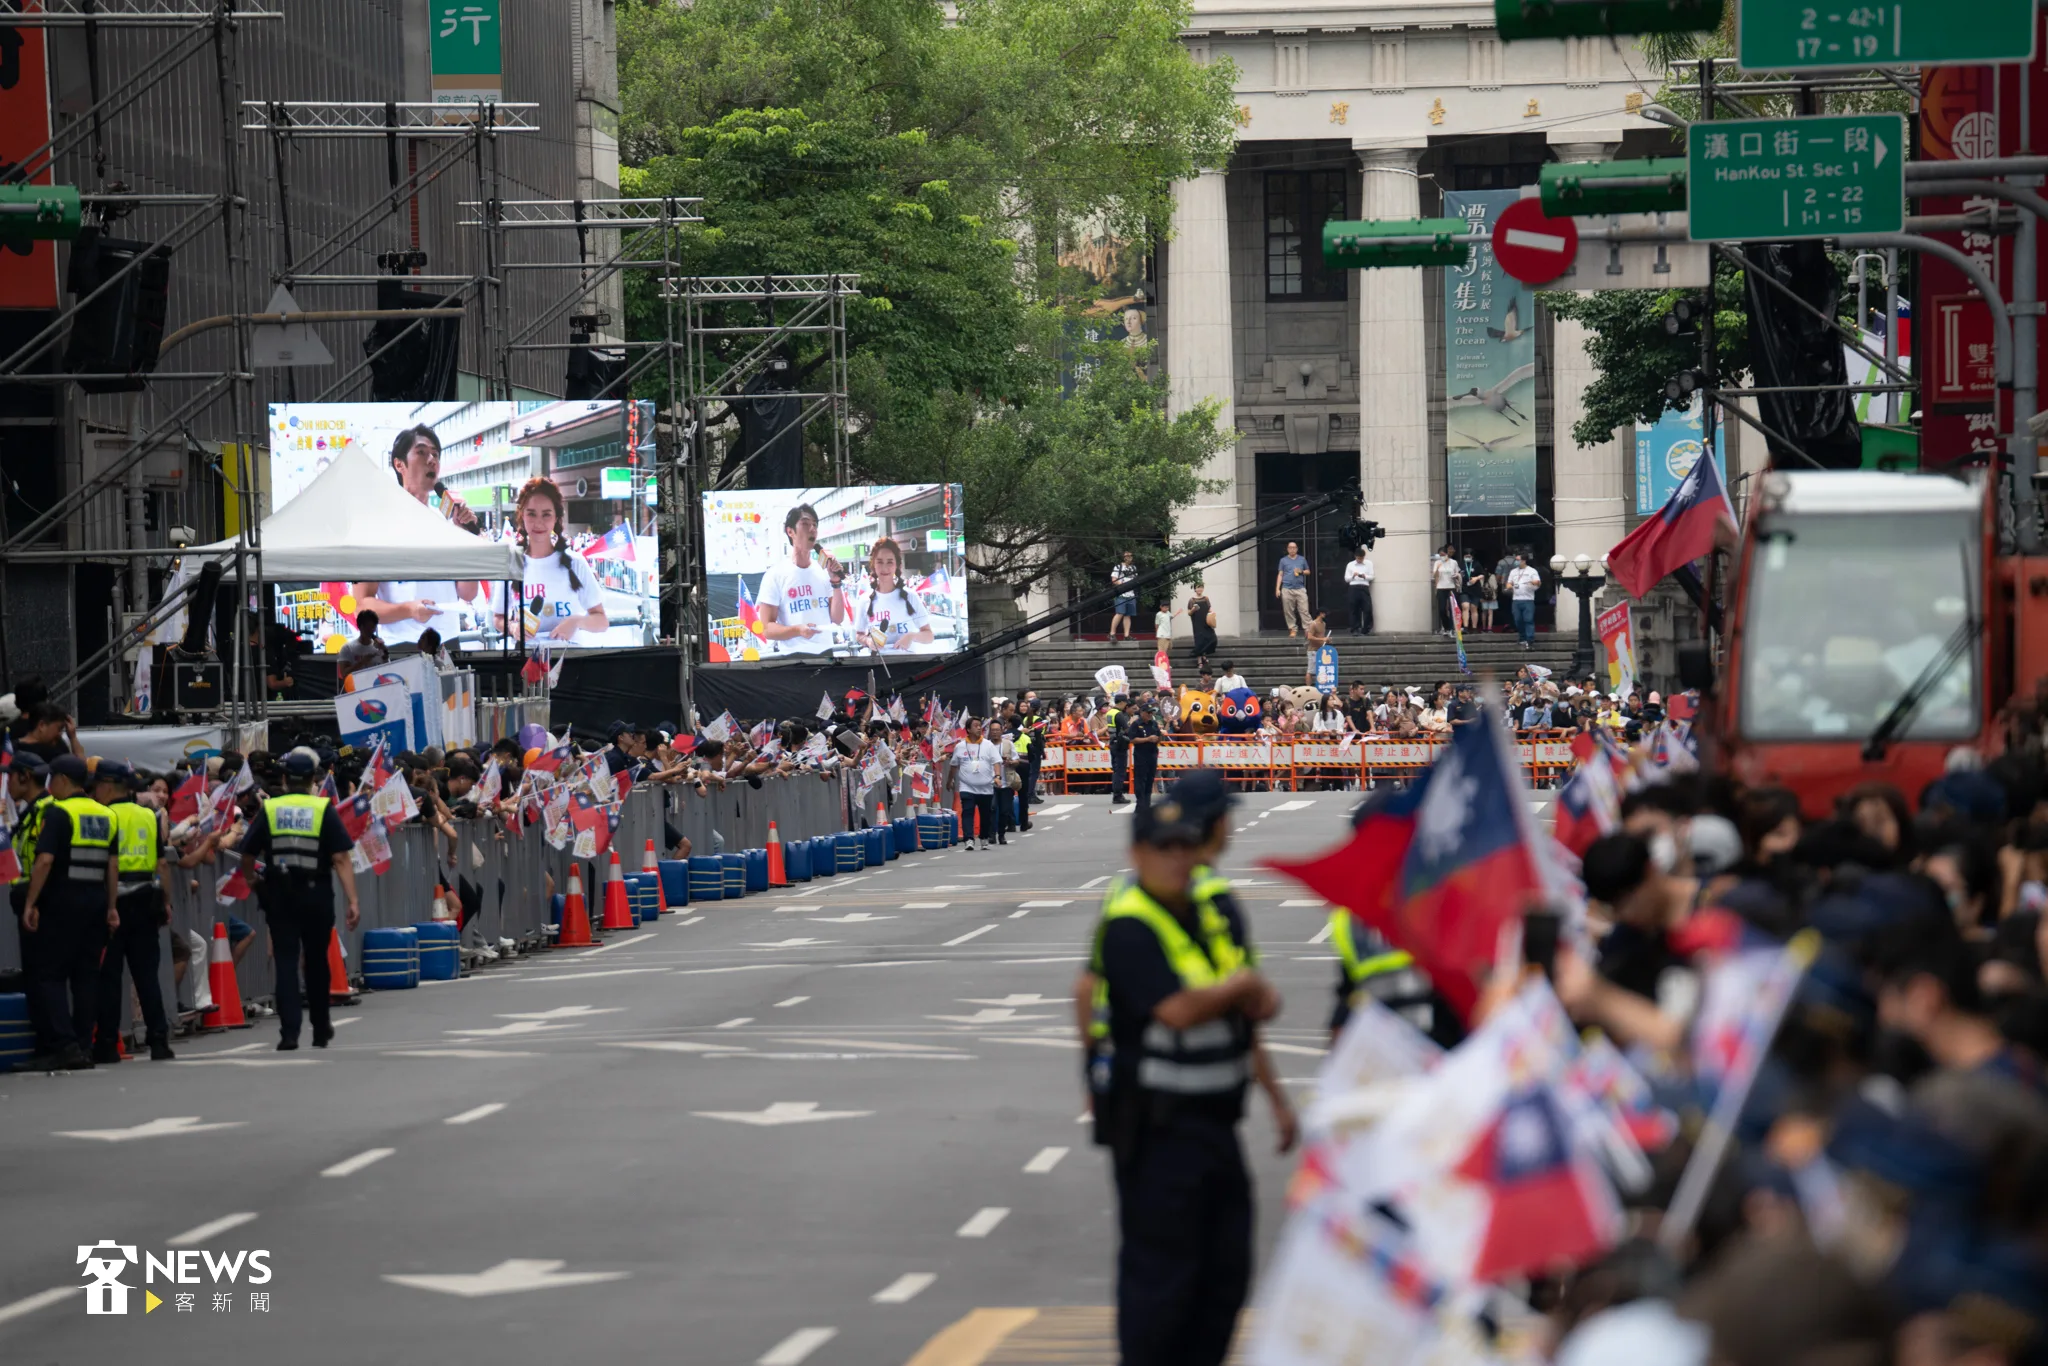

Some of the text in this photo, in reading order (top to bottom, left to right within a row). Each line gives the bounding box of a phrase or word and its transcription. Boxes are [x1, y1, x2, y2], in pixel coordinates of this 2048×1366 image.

[1801, 8, 1817, 30] 2
[440, 6, 491, 46] 行
[1797, 37, 1821, 59] 17
[1853, 35, 1879, 57] 19
[1703, 126, 1869, 160] 漢口街一段
[1715, 165, 1781, 182] HanKou
[1852, 161, 1859, 175] 1
[1804, 188, 1817, 204] 2
[1841, 186, 1863, 202] 22
[1843, 207, 1862, 224] 15
[1455, 315, 1490, 324] Across
[1455, 326, 1474, 334] The
[1455, 337, 1486, 346] Ocean
[1456, 352, 1486, 361] Taiwan's
[1456, 362, 1490, 370] Migratory
[1456, 372, 1475, 380] Birds
[1212, 747, 1263, 759] 禁止進入
[1303, 746, 1353, 757] 禁止進入
[1373, 745, 1424, 757] 禁止進入
